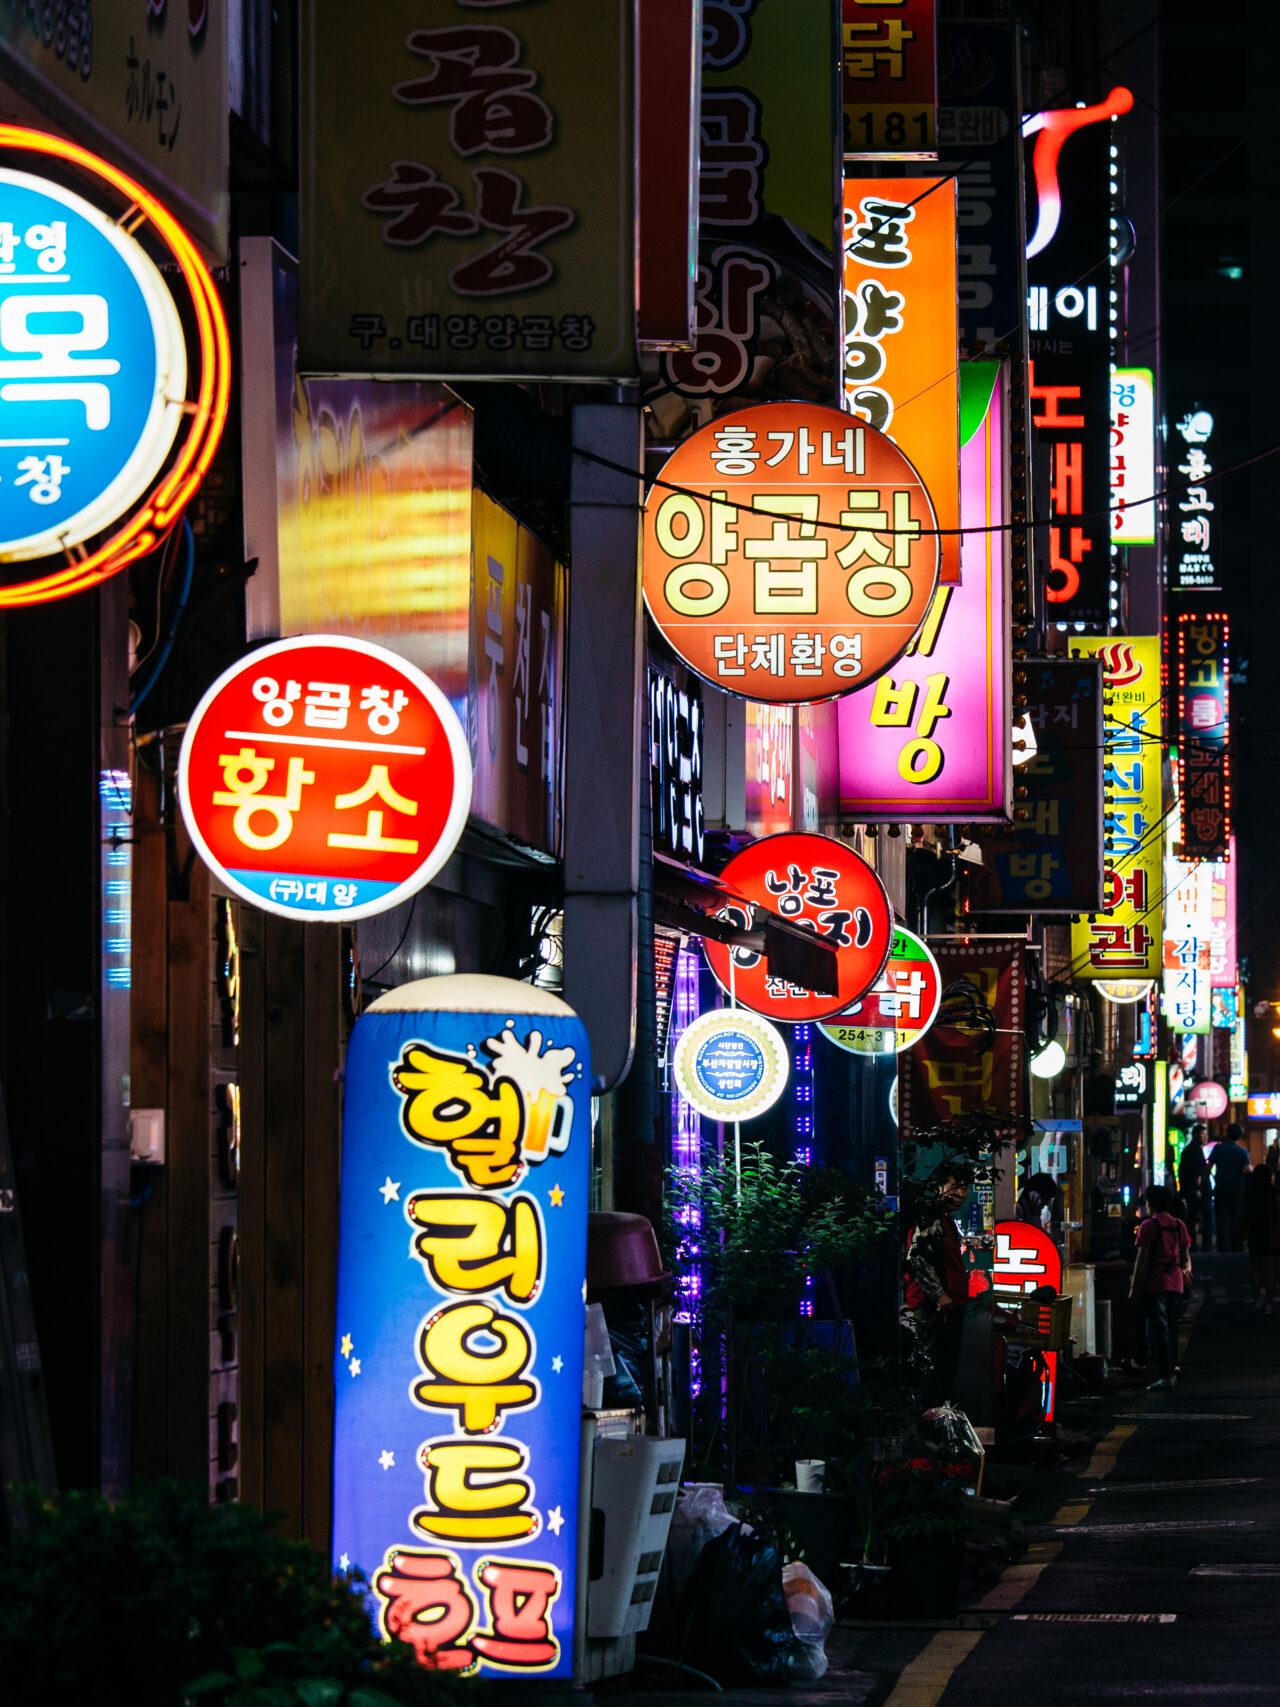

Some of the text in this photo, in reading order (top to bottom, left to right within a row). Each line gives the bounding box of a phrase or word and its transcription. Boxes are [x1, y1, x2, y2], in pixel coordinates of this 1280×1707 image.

[709, 425, 867, 477] 홍가네
[14, 454, 71, 505] 창
[655, 489, 921, 619] 양곱창
[713, 632, 864, 679] 단체환영
[252, 676, 409, 736] 양곱창
[212, 747, 419, 855] 황소
[1173, 935, 1203, 1029] 감자탕
[838, 1028, 907, 1043] 254-31
[1115, 1062, 1147, 1094] 래
